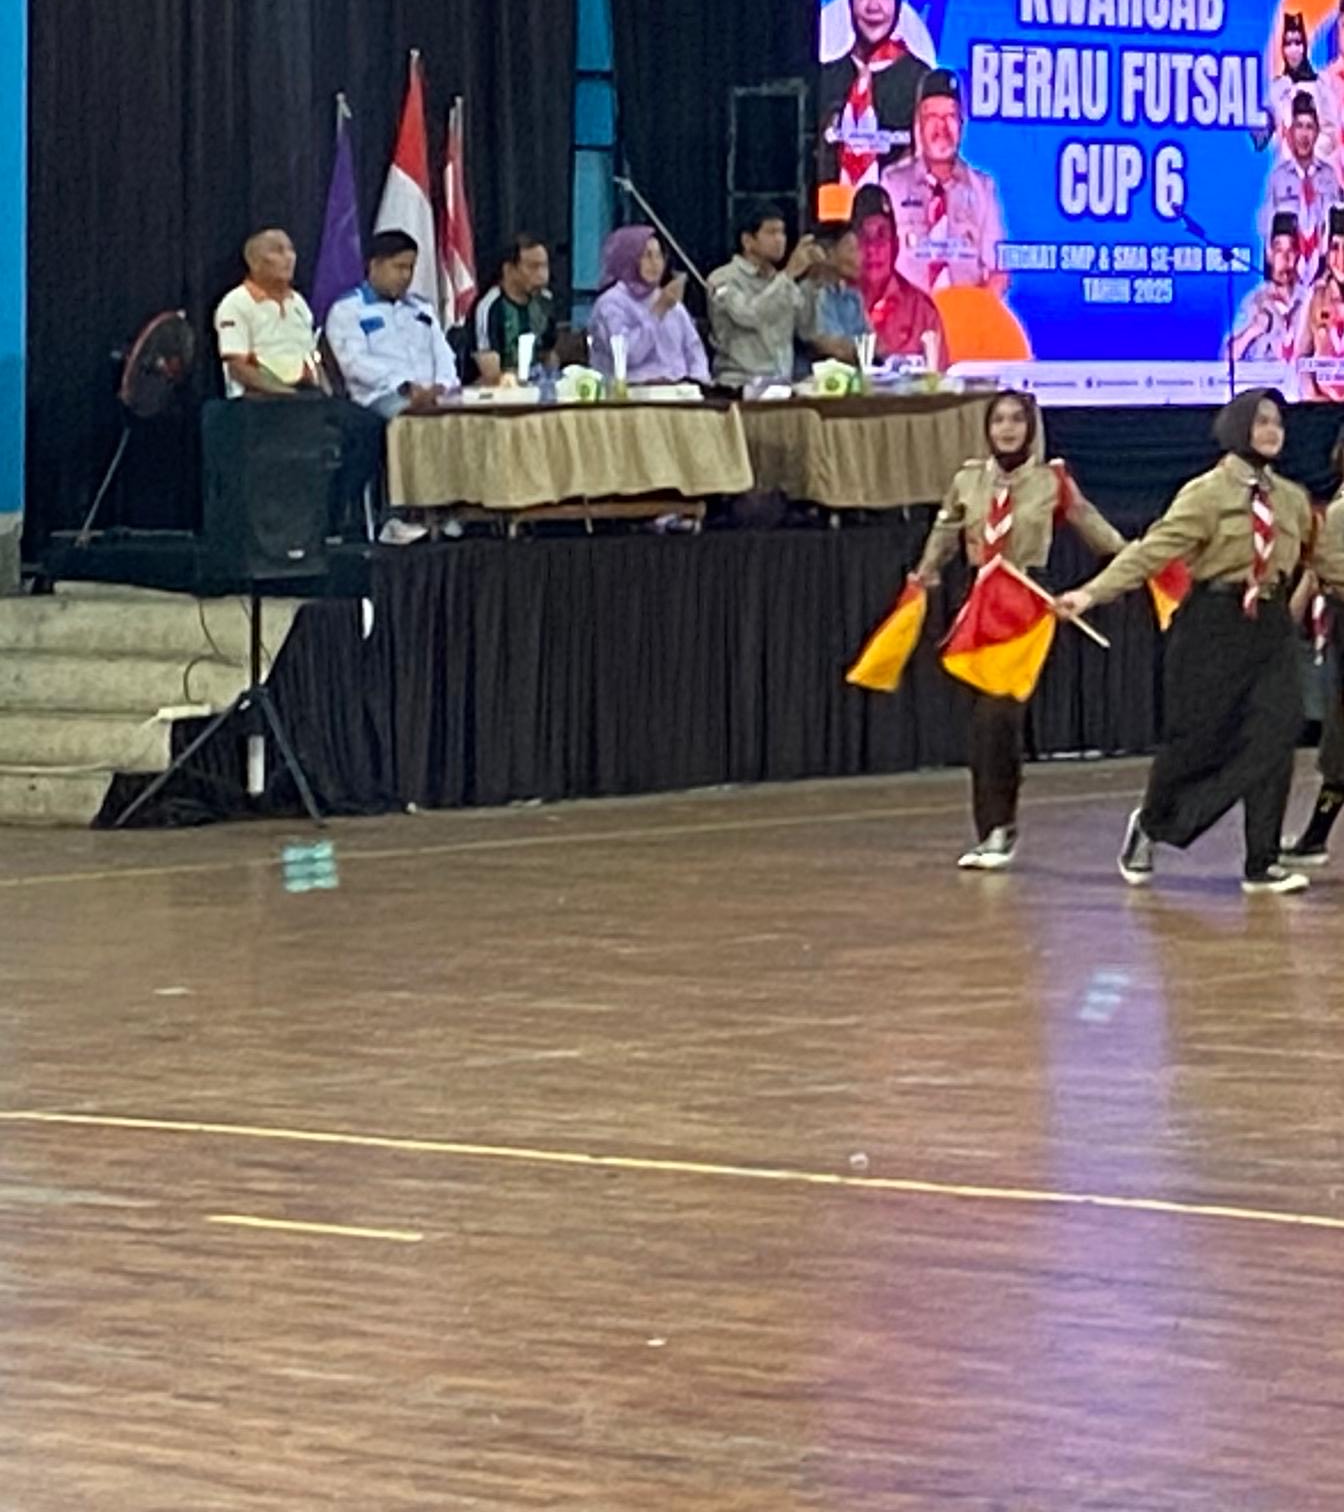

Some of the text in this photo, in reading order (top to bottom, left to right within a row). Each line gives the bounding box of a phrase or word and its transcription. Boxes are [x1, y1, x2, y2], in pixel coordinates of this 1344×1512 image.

[971, 44, 1268, 127] BERAU FUTSAL
[1060, 143, 1185, 218] CUP 6
[1060, 244, 1096, 271] SMP
[1113, 245, 1149, 271] SMA
[1133, 277, 1173, 304] 2025
